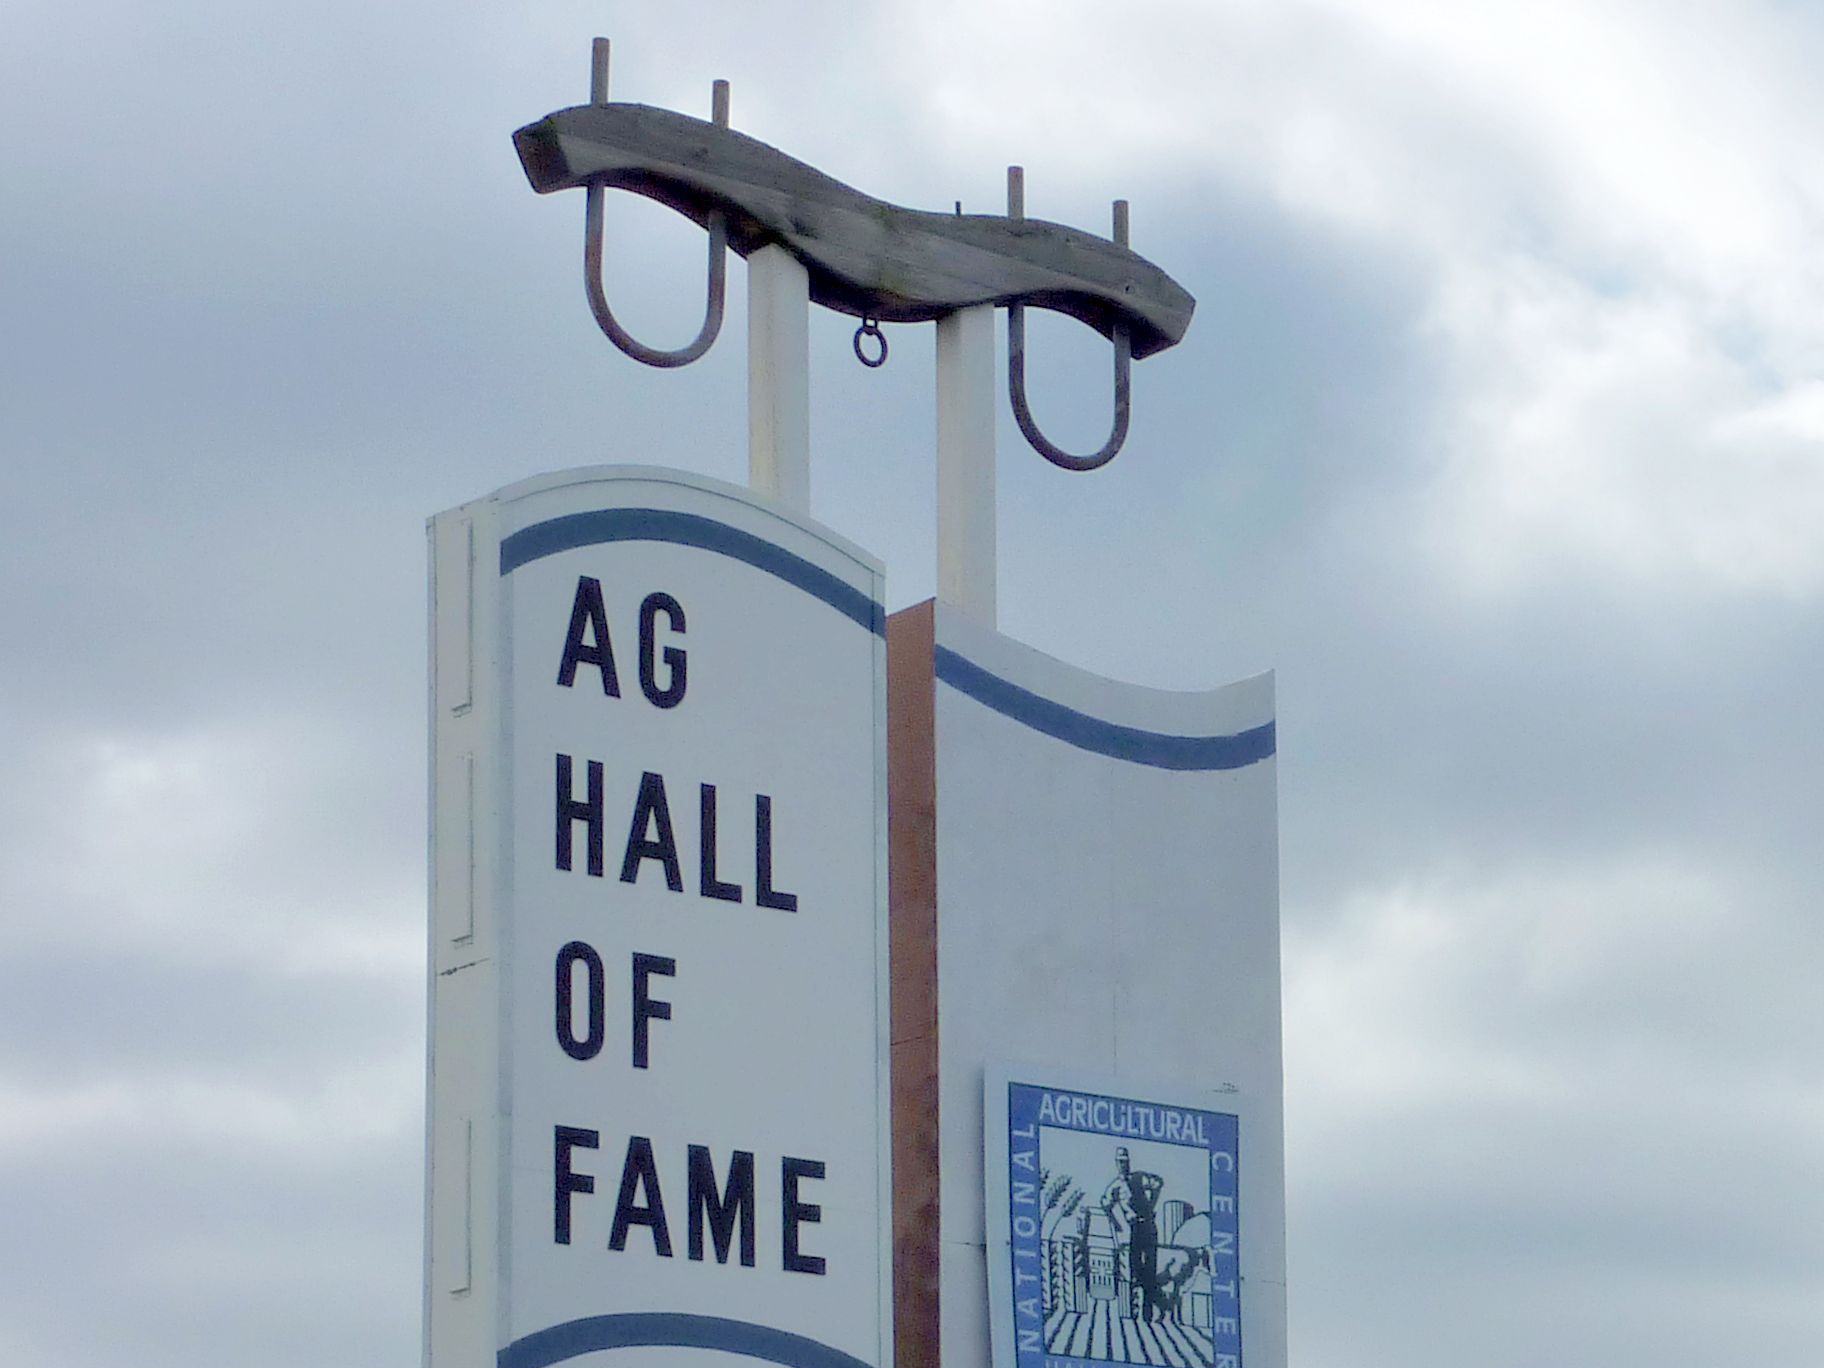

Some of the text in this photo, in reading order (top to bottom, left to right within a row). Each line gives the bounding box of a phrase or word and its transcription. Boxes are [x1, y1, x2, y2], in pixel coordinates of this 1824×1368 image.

[556, 575, 688, 709] AG
[555, 753, 798, 912] HALL
[555, 941, 676, 1070] OF
[1039, 1093, 1210, 1144] AGRICULTURAL
[553, 1124, 826, 1276] FAME
[1013, 1123, 1041, 1352] NATIONAL
